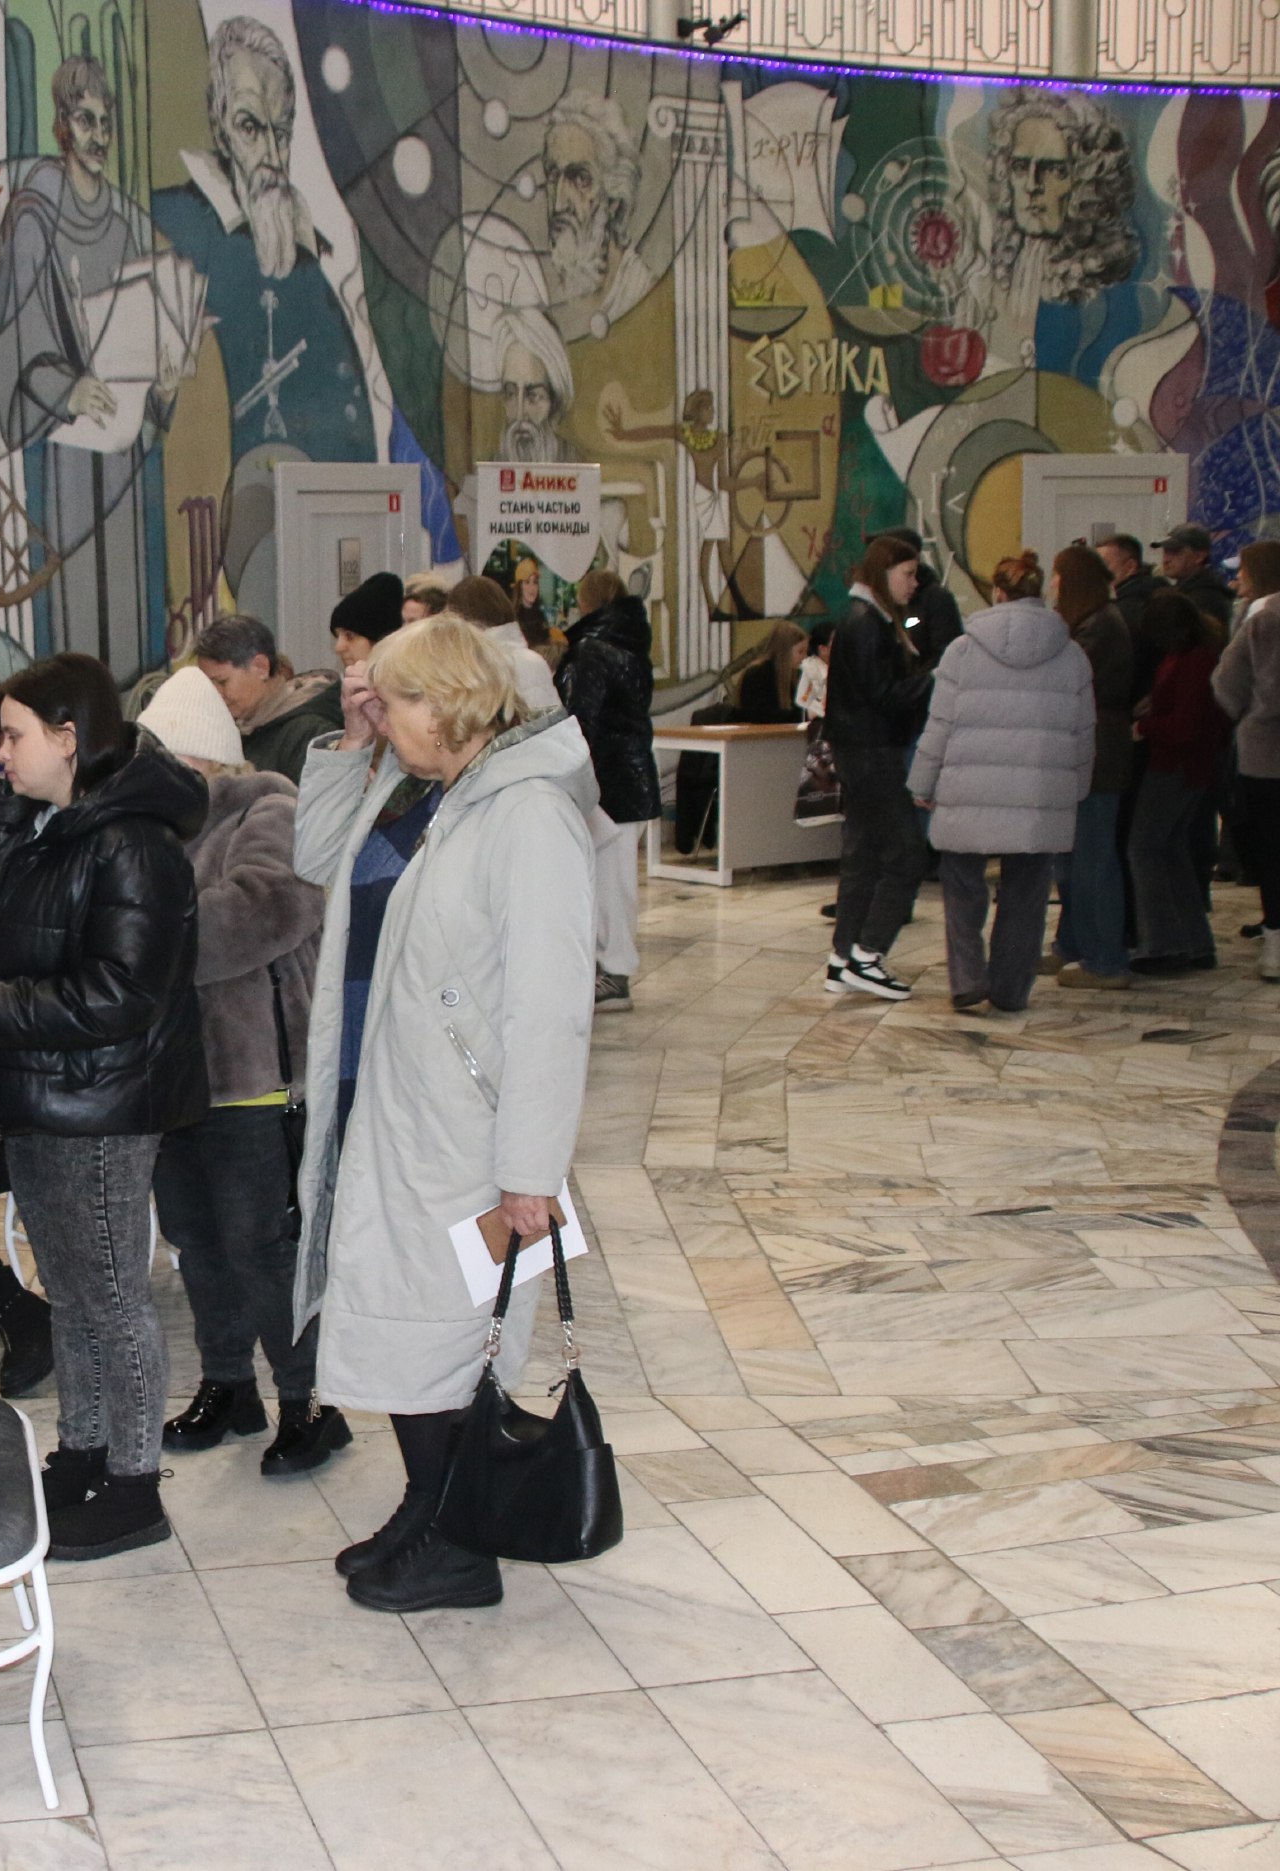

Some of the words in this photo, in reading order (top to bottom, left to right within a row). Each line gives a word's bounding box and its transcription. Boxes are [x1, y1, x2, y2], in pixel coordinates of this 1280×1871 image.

[522, 471, 577, 491] Аникс
[500, 501, 535, 514] СТАНЬ
[537, 501, 581, 514] ЧАСТЬЮ
[490, 520, 532, 534] НАШЕЙ
[536, 521, 590, 535] КОМАНДЫ
